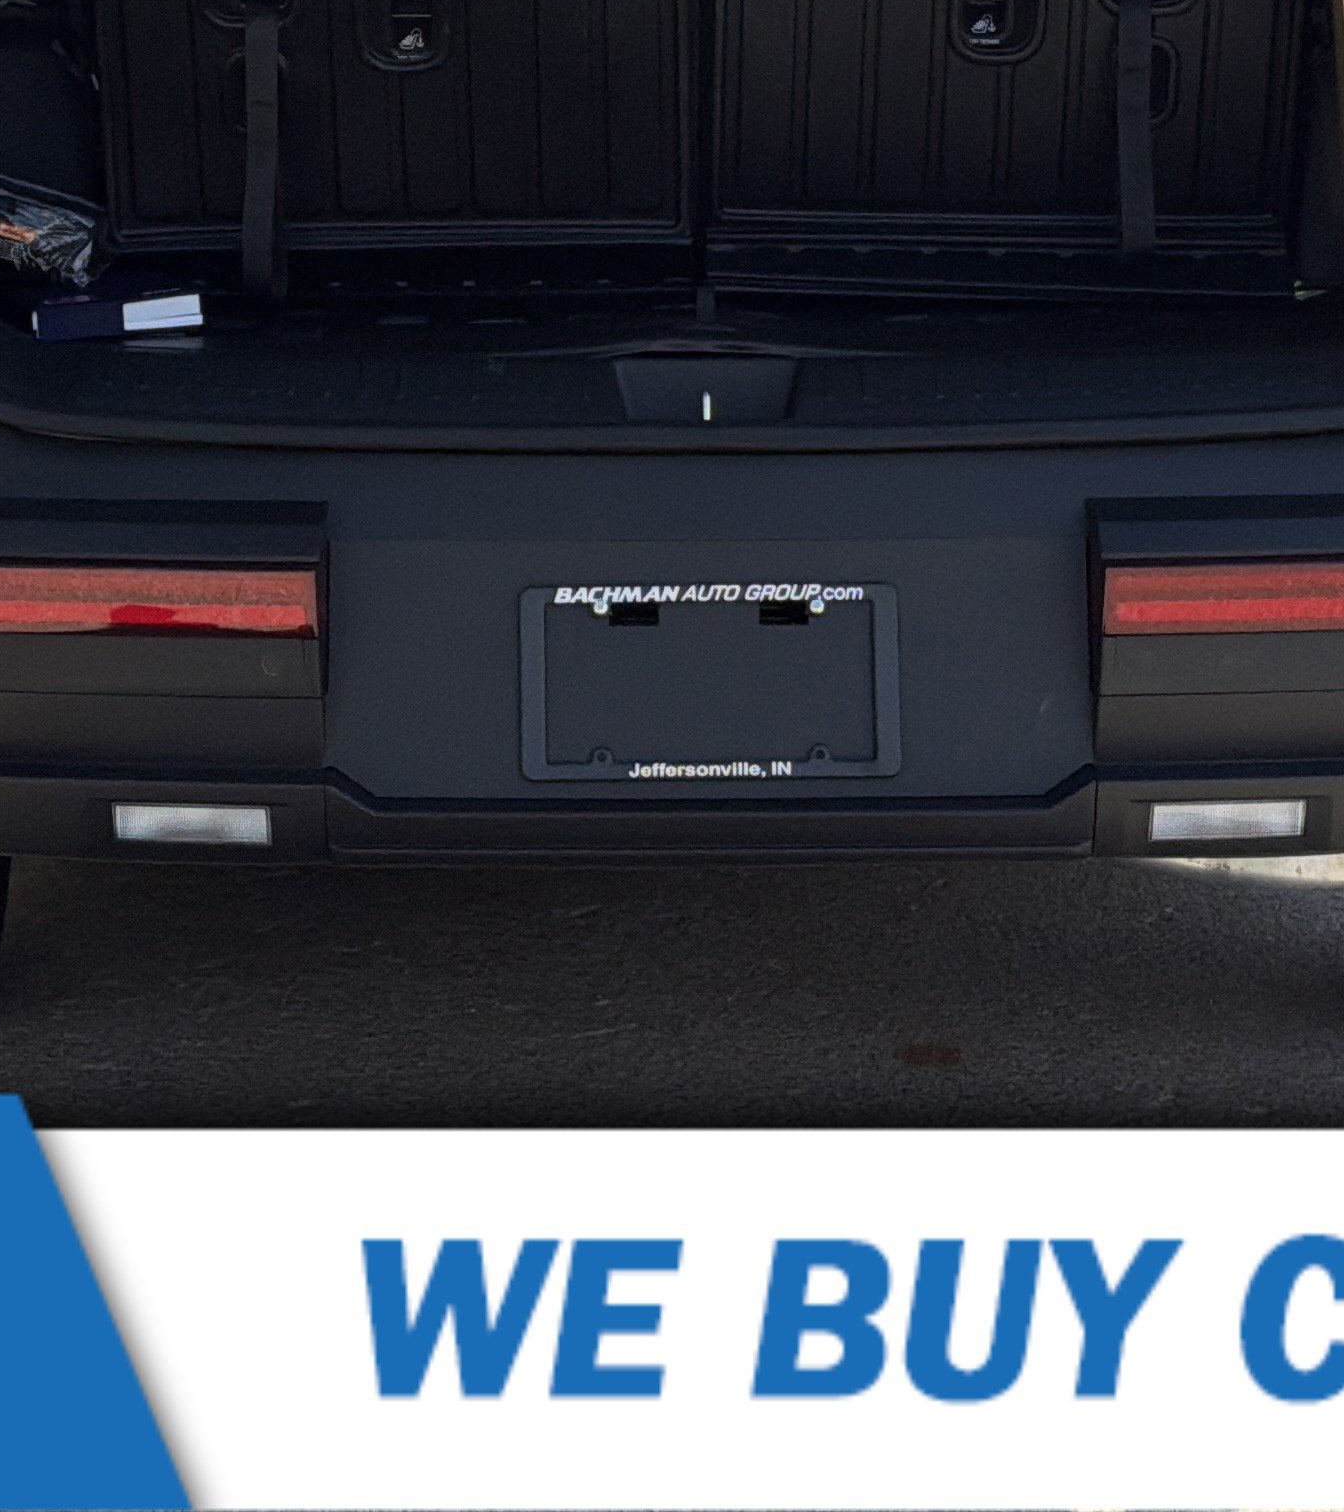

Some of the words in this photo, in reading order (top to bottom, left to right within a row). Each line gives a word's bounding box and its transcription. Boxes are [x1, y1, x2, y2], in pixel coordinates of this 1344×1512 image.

[554, 585, 680, 604] BACHMAN
[681, 584, 741, 602] AUTO
[628, 762, 767, 778] Jeffersonville,
[771, 761, 792, 776] IN
